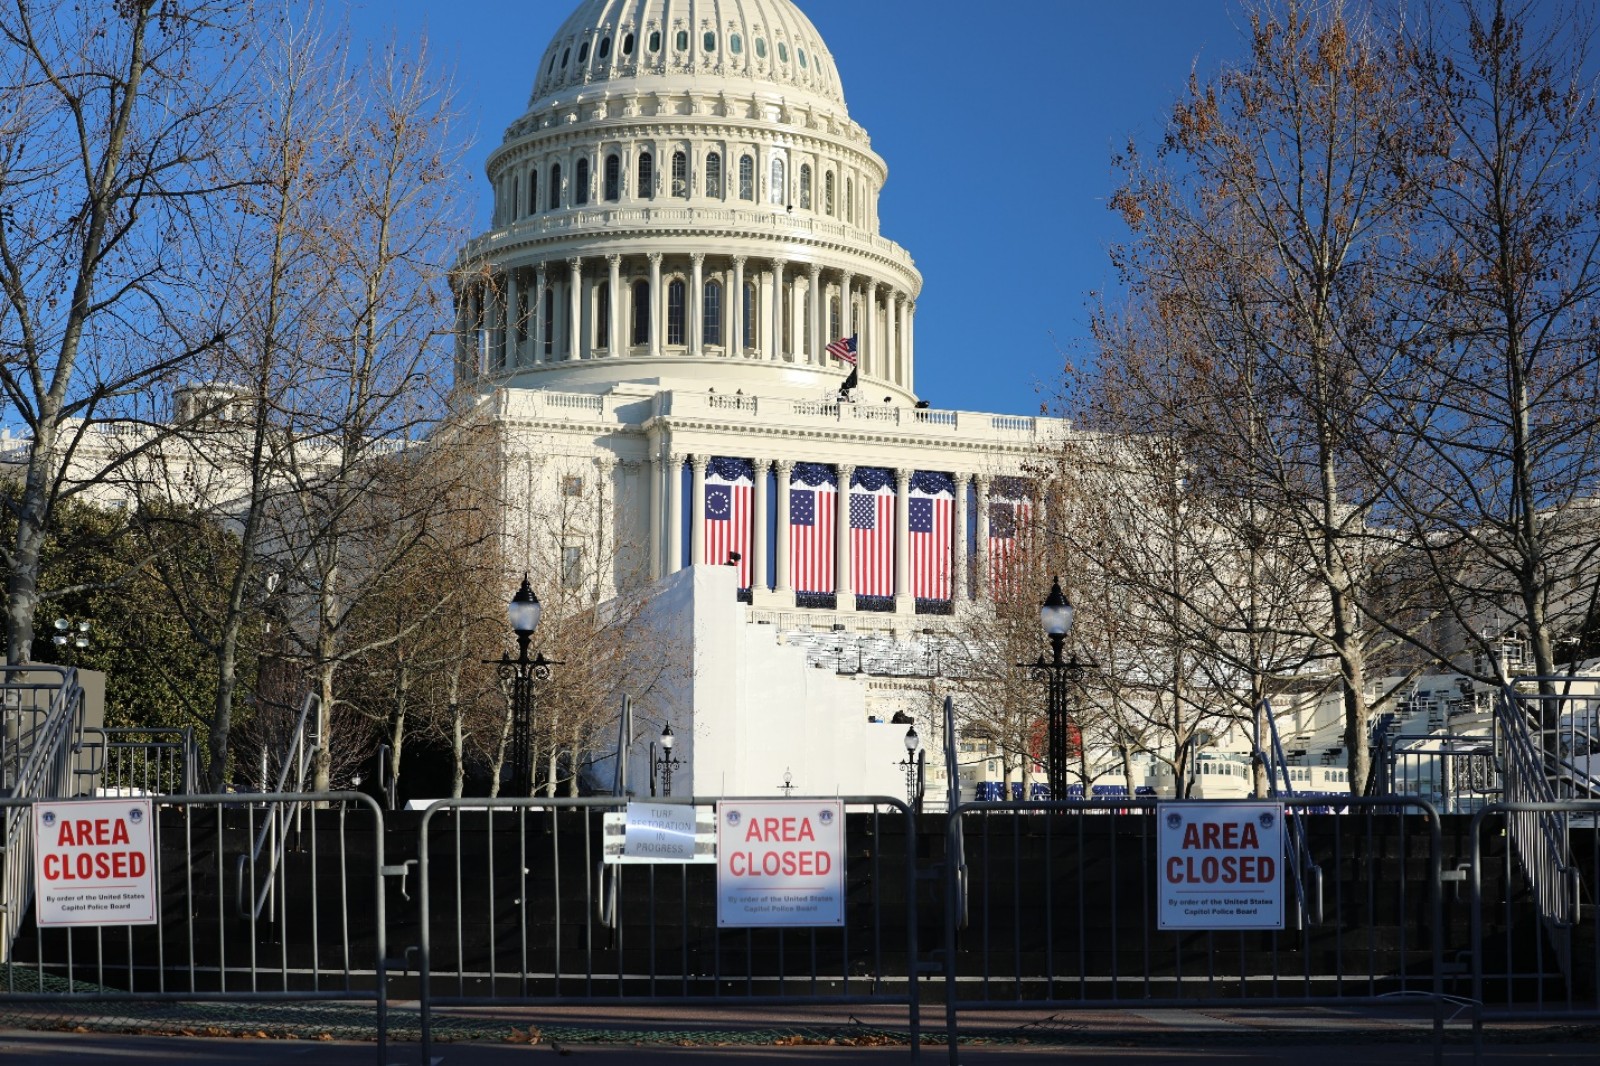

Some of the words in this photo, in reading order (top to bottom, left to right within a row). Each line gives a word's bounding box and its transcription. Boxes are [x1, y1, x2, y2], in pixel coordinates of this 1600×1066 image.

[632, 820, 691, 830] RESTORATION
[651, 810, 673, 818] TURF
[58, 818, 130, 846] AREA
[745, 817, 815, 842] AREA
[1182, 823, 1259, 849] AREA
[637, 843, 683, 853] PROGRESS
[43, 852, 146, 880] CLOSED
[730, 851, 831, 876] CLOSED
[1167, 856, 1275, 884] CLOSED
